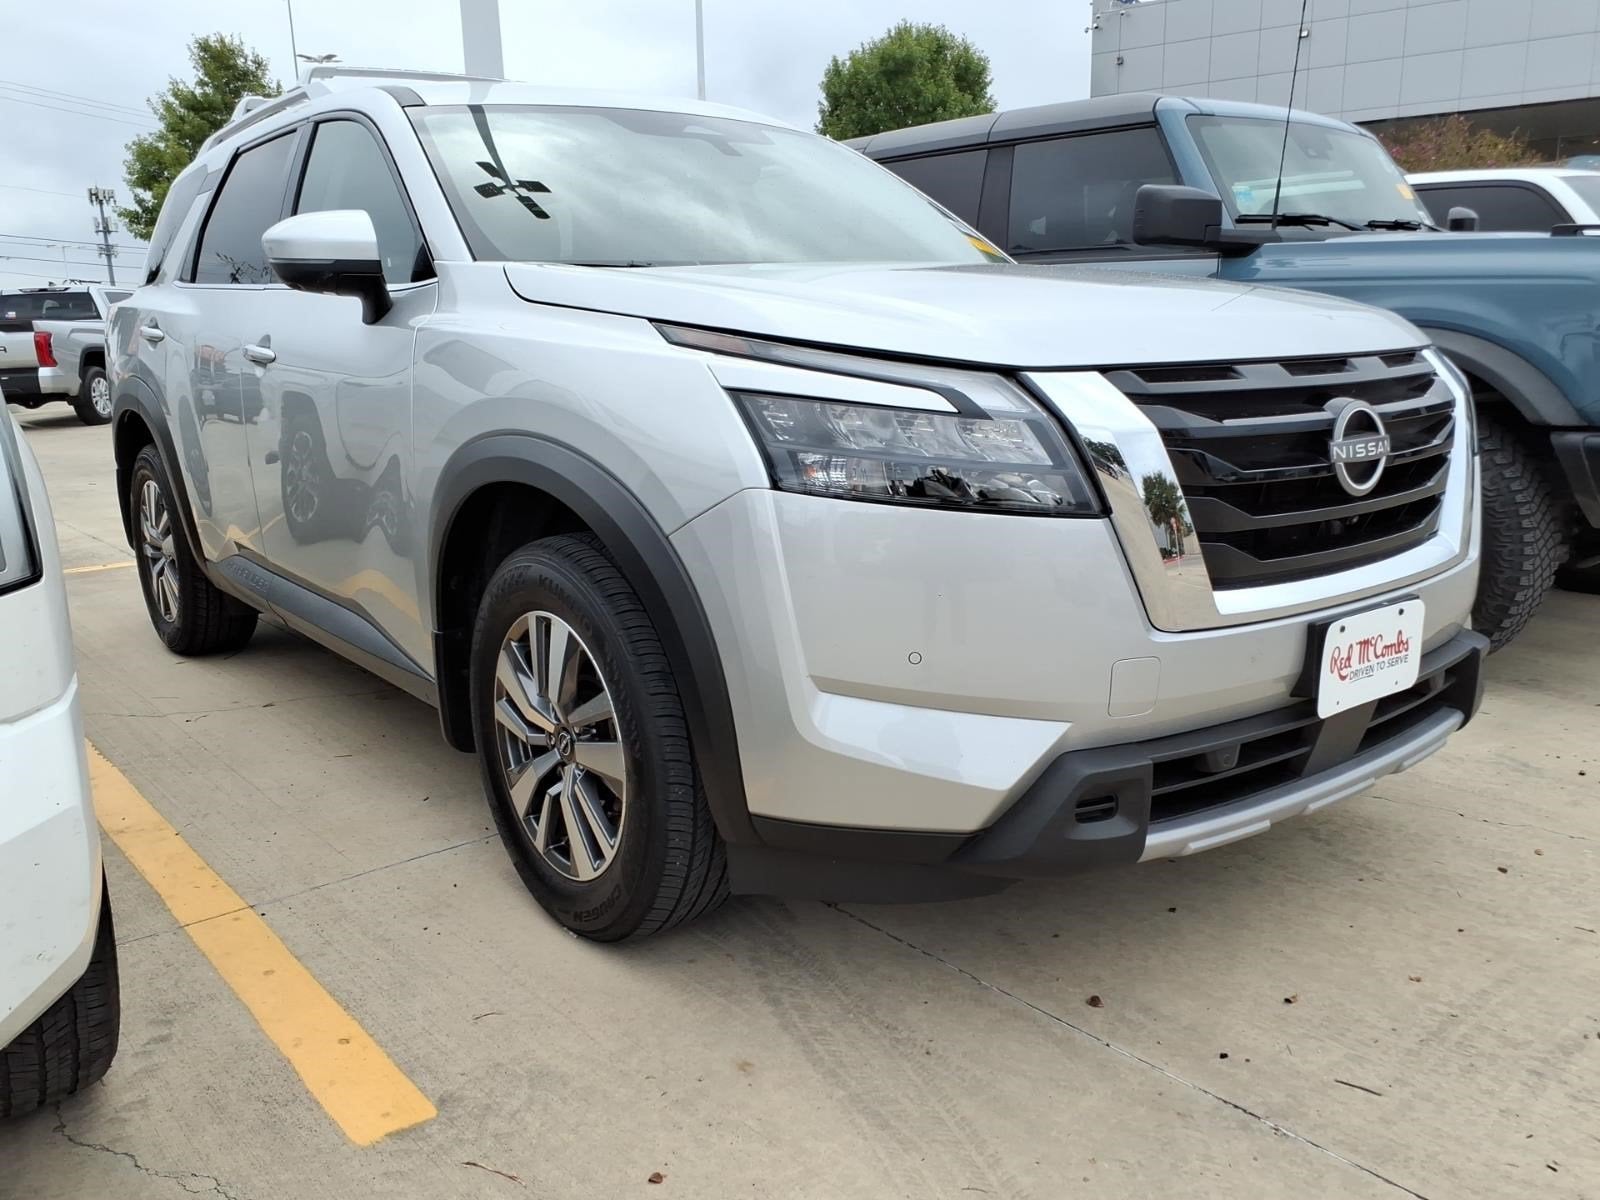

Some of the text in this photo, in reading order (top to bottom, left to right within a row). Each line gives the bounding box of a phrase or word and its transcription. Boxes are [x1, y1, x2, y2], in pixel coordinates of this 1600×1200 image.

[1332, 440, 1390, 459] NISSAN
[1330, 629, 1409, 681] Red McCombs
[1349, 654, 1409, 680] DRIVEN TO SERVE
[573, 883, 622, 923] CRUGEN
